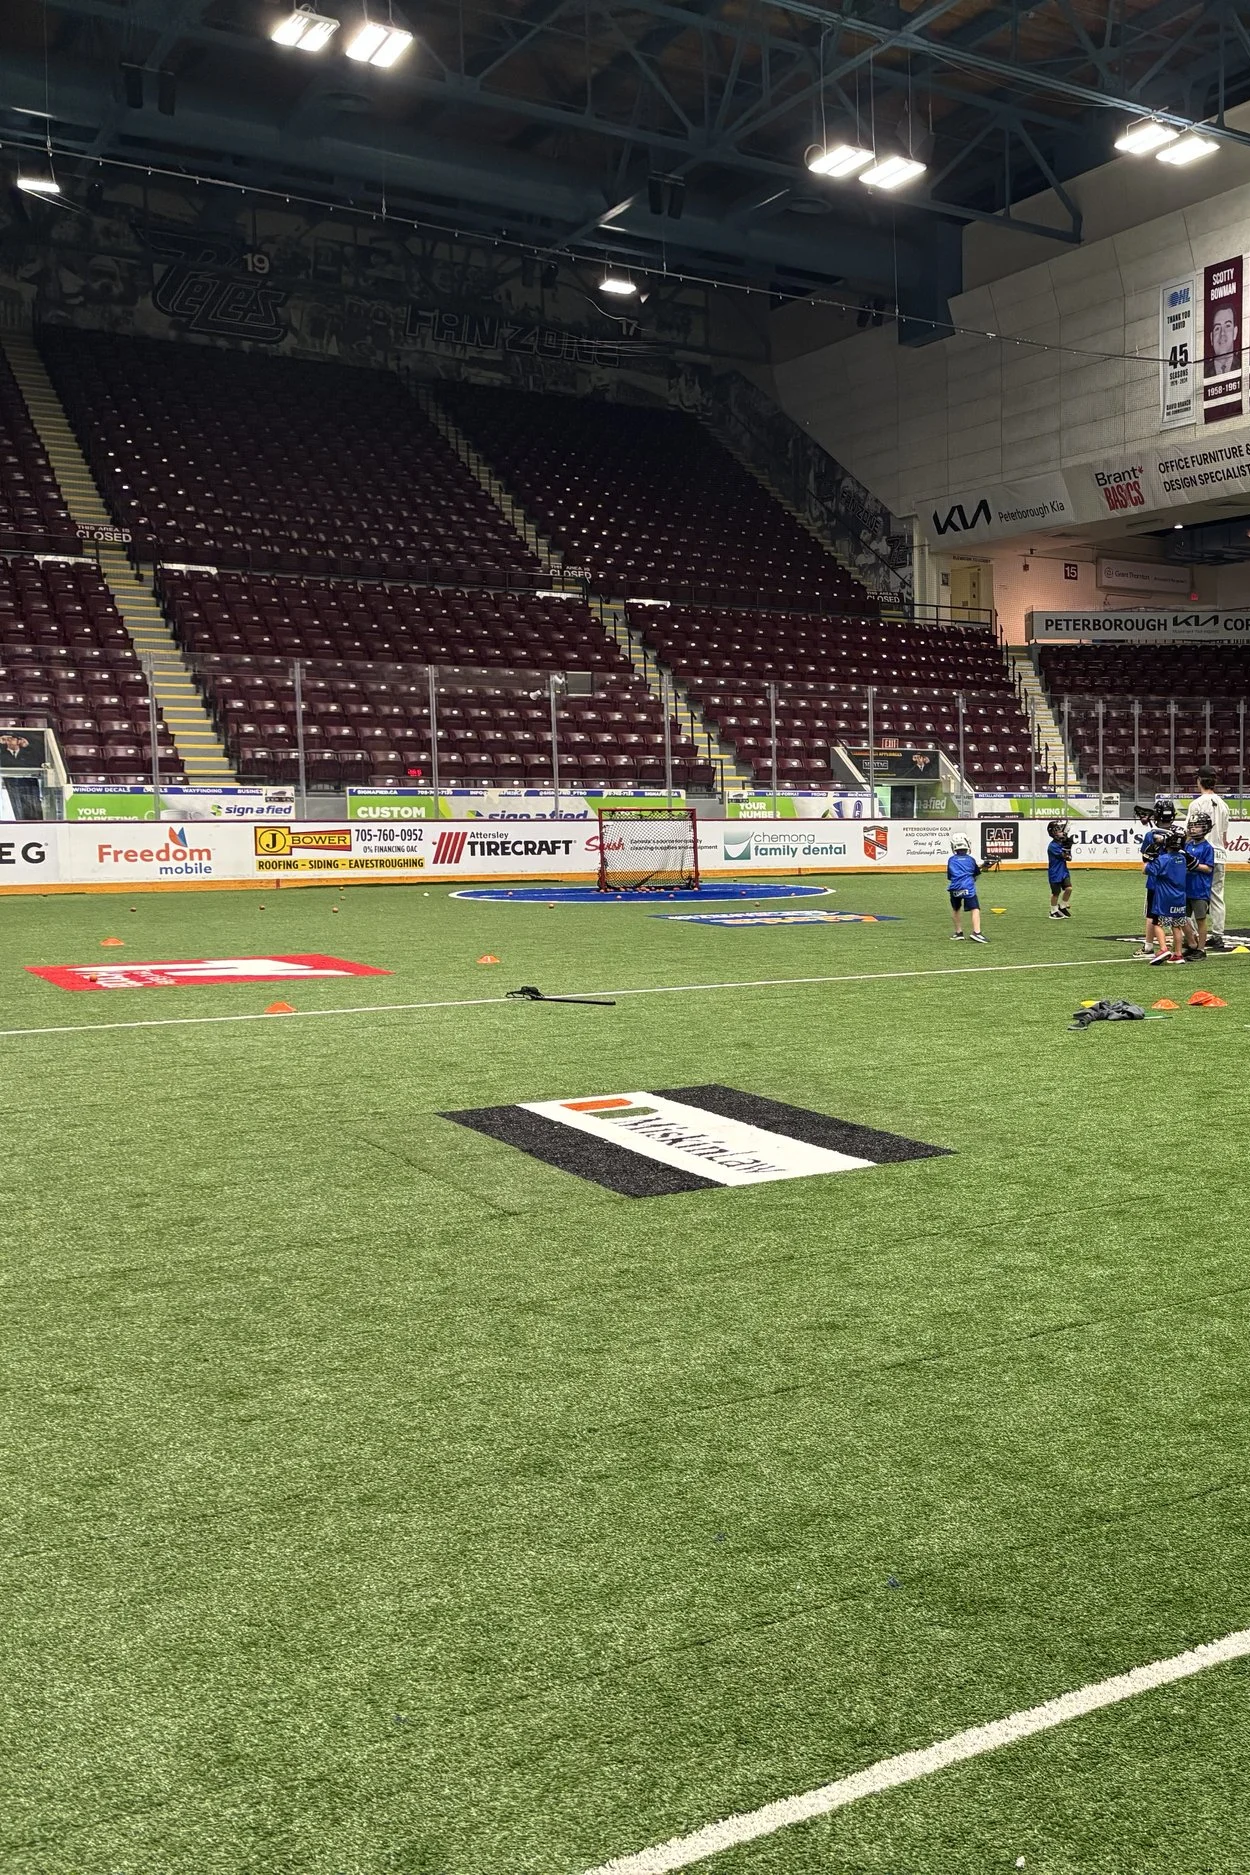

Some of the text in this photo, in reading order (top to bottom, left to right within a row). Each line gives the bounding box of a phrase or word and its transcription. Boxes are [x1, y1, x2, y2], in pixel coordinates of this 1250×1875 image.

[243, 252, 270, 275] 19
[1212, 268, 1234, 286] SCOTTY
[1210, 283, 1237, 301] BOWMAN
[1168, 342, 1188, 370] 45
[1207, 382, 1241, 397] 1958-1961
[1158, 456, 1190, 475] OFFICE
[1190, 446, 1243, 469] FURNITURE
[1094, 466, 1139, 488] Brant
[1163, 474, 1198, 493] DESIGN
[1103, 480, 1145, 512] BASICS
[998, 500, 1065, 524] Peterborough Kia
[76, 529, 132, 543] CLOSED
[1064, 565, 1078, 579] 15
[1044, 618, 1168, 632] PETERBOROUGH
[884, 738, 898, 748] EXIT
[77, 807, 107, 817] YOUR
[357, 807, 427, 818] CUSTOM
[740, 802, 767, 810] YOUR
[265, 832, 348, 850] J BOWER
[355, 829, 424, 842] 705-760-0952
[469, 831, 509, 840] Attersley
[753, 832, 816, 844] chemong
[985, 827, 1014, 841] FAT
[1072, 827, 1143, 845] cLeod's
[97, 842, 212, 863] Freedom
[374, 845, 406, 854] FINANCING
[406, 845, 418, 853] OAC
[467, 840, 573, 857] TIRECRAFT
[754, 844, 847, 858] family dental
[159, 862, 213, 875] mobile
[258, 858, 424, 870] ROOFING SIDING EAVESTROUGHING
